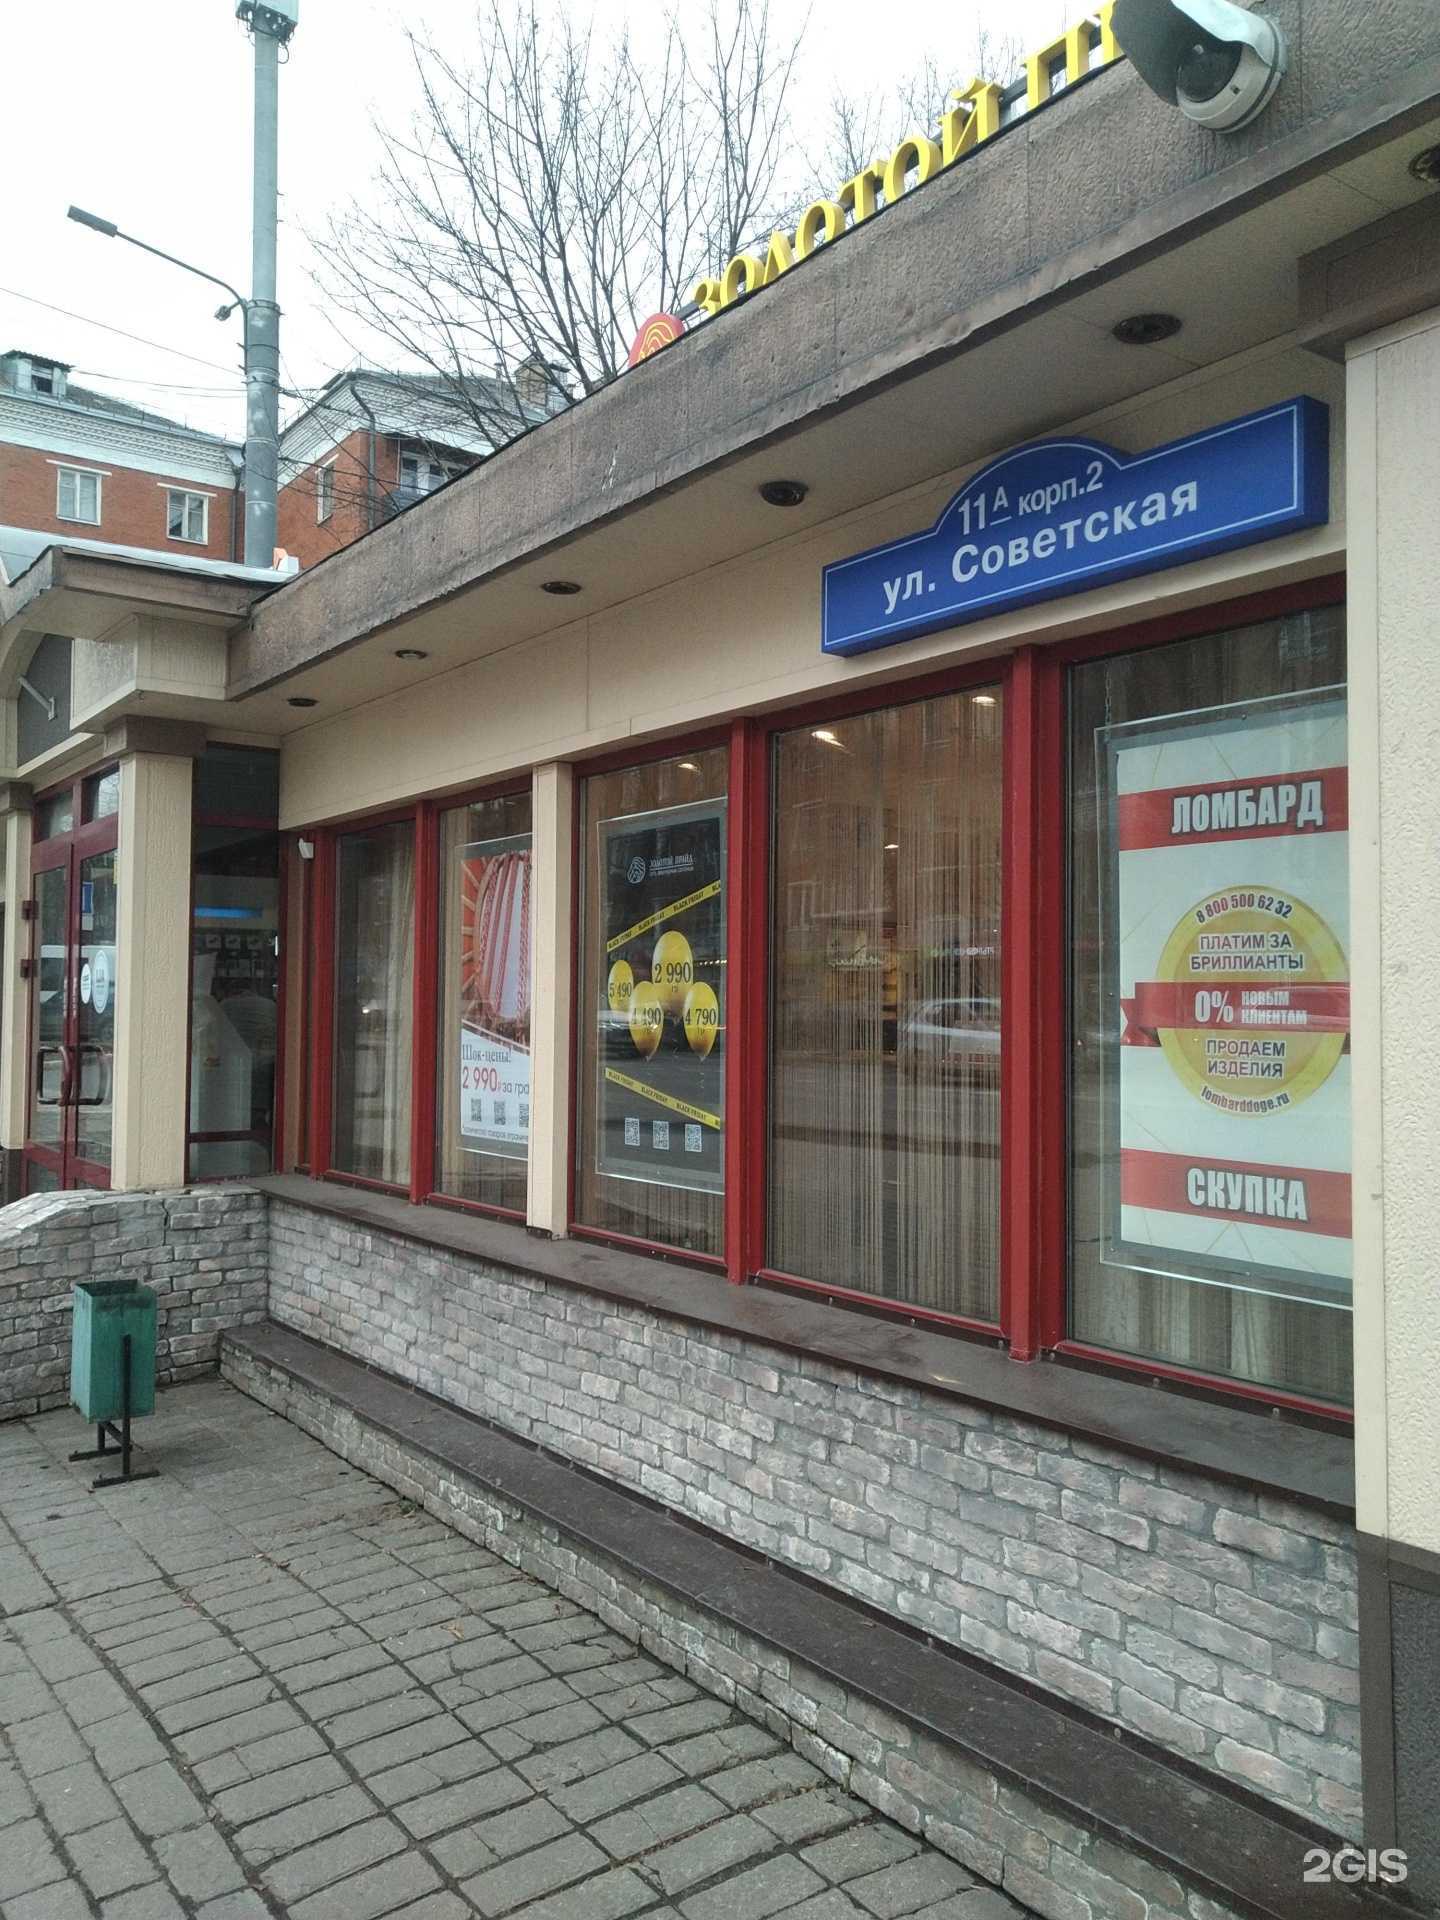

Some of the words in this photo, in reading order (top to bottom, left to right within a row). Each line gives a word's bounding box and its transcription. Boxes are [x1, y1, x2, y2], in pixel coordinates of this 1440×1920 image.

[693, 77, 1003, 314] ЗОЛОТОЙ
[883, 569, 935, 615] ул.
[951, 481, 1198, 583] Советская
[1172, 780, 1324, 834] ЛОМБАРД
[1196, 910, 1205, 923] 8
[1205, 897, 1228, 917] 800
[1231, 894, 1254, 908] 500
[1258, 895, 1274, 911] 62
[1275, 900, 1292, 918] 32
[1200, 934, 1265, 950] ПЛАТИМ
[1270, 933, 1292, 948] ЗА
[655, 963, 662, 983] 2
[666, 962, 691, 983] 990
[1191, 954, 1303, 970] БРИЛЛИАНТЫ
[1195, 990, 1233, 1023] 0%
[1241, 991, 1289, 1005] НОВЫМ
[684, 1009, 691, 1025] 4
[696, 1008, 716, 1025] 790
[1206, 1039, 1285, 1057] ПРОДАЕМ
[463, 1066, 469, 1088] 2
[473, 1067, 497, 1092] 990
[502, 1082, 513, 1093] за
[1207, 1060, 1283, 1078] ИЗДЕЛИЯ
[1201, 1085, 1290, 1112] lombarddoge.ru
[1187, 1167, 1309, 1221] СКУПКА
